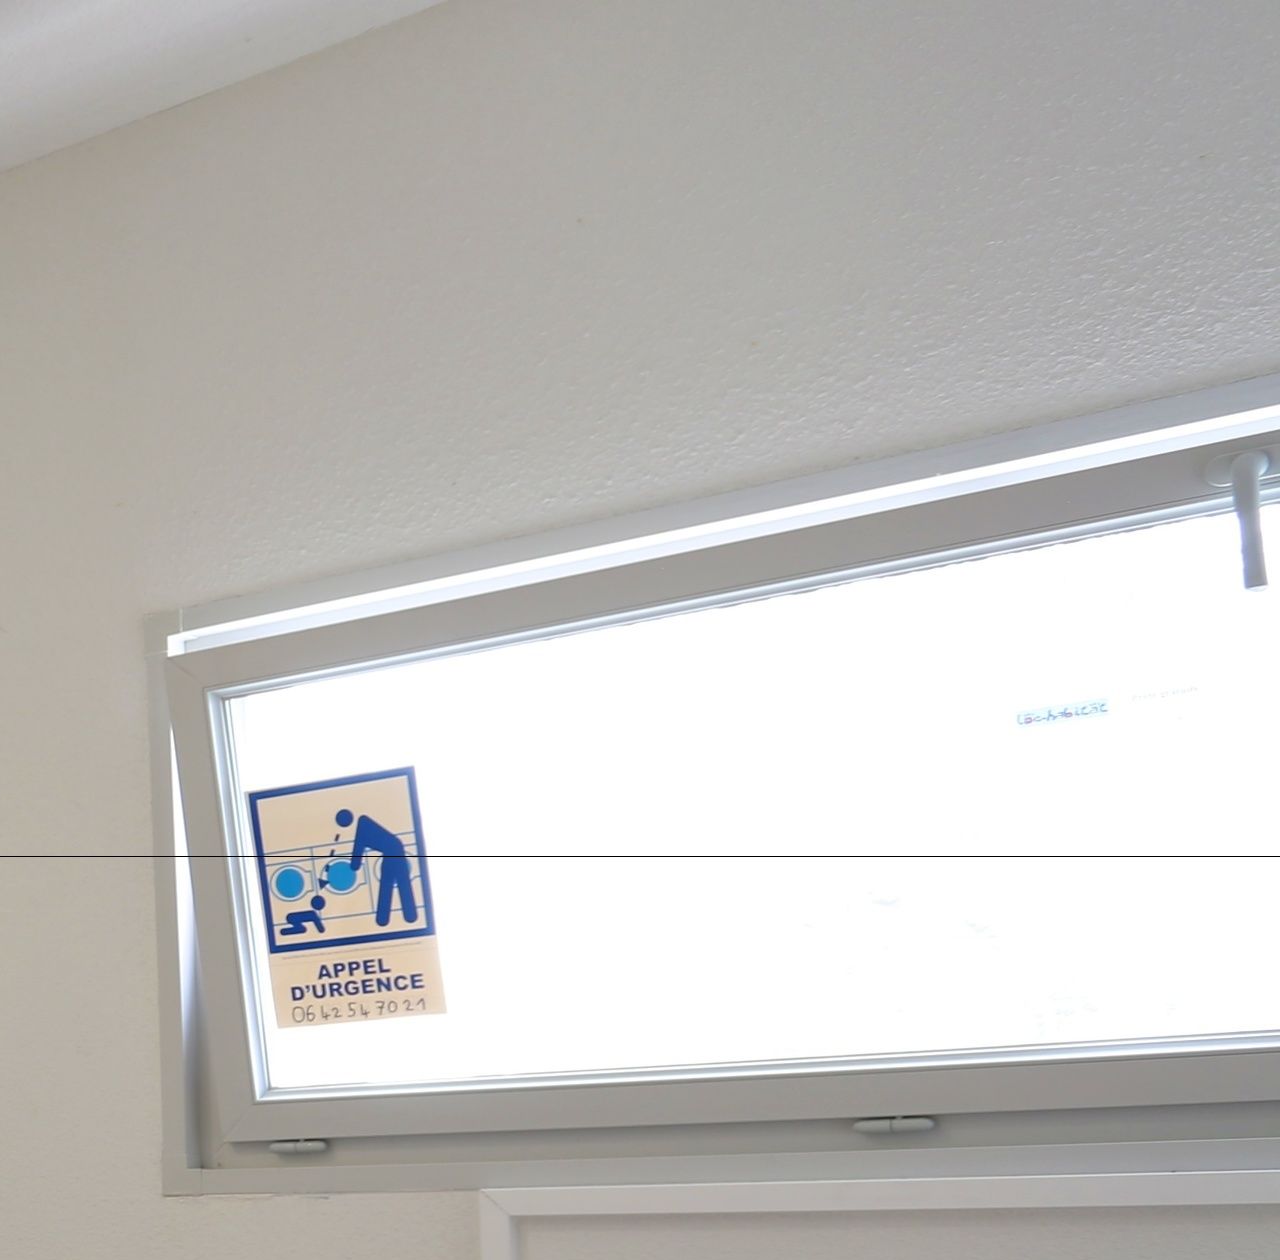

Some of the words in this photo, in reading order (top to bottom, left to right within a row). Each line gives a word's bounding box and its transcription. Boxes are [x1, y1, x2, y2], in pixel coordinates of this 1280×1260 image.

[318, 958, 391, 980] APPEL
[290, 973, 426, 1002] D'URGENCE
[292, 1005, 315, 1024] 06
[320, 1003, 341, 1020] 42
[347, 1002, 370, 1019] 54
[376, 1000, 398, 1015] 70
[403, 998, 427, 1012] 21
